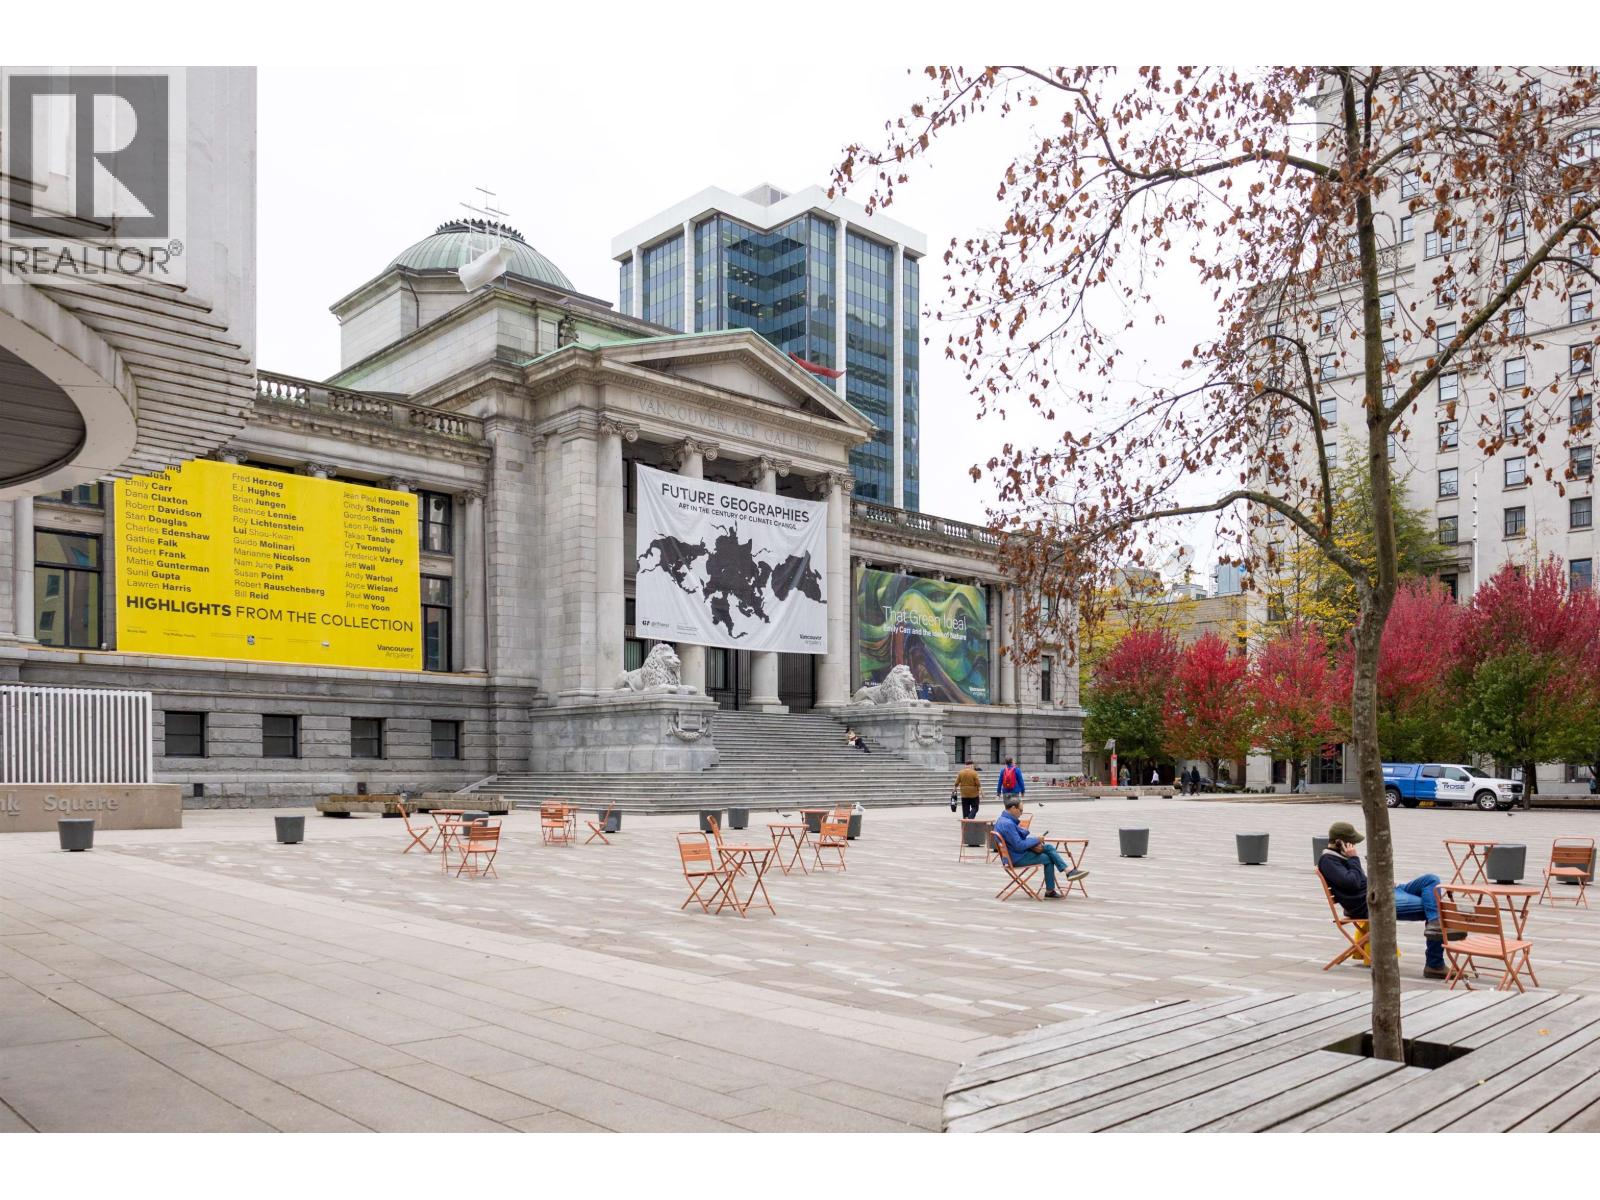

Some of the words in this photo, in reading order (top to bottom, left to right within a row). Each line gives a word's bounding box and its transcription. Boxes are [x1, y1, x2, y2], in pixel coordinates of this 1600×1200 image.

[639, 399, 728, 432] VANCOUVER
[732, 423, 759, 438] ART
[764, 430, 820, 454] GALLERY
[126, 479, 149, 489] Emily
[152, 482, 172, 492] Carr
[232, 473, 250, 482] Fred
[253, 477, 284, 489] Herzog
[126, 489, 148, 499] Dana
[151, 493, 188, 505] Claxton
[248, 487, 280, 498] Hughes
[233, 494, 253, 504] Brian
[256, 498, 286, 509] Jungen
[378, 497, 409, 507] Riopelle
[661, 483, 715, 506] FUTURE
[720, 496, 810, 523] GEOGRAPHIES
[126, 500, 154, 510] Robert
[158, 505, 202, 518] Davidson
[233, 505, 265, 516] Beatrice
[268, 510, 296, 520] Lennie
[344, 502, 364, 511] Cindy
[366, 505, 400, 515] Sherman
[678, 502, 690, 510] ART
[712, 508, 738, 519] CENTURY
[748, 516, 773, 526] CLIMATE
[126, 512, 146, 520] Stan
[149, 515, 188, 526] Douglas
[233, 516, 248, 525] Roy
[250, 518, 304, 531] Lichtenstein
[344, 512, 370, 520] Gordon
[372, 516, 394, 524] Smith
[126, 522, 159, 534] Charles
[162, 528, 210, 540] Edenshaw
[381, 526, 402, 535] Smith
[126, 534, 155, 544] Gathie
[158, 538, 178, 547] Falk
[233, 537, 257, 546] Guido
[260, 540, 295, 551] Molinari
[367, 534, 395, 543] Tanabe
[126, 545, 156, 555] Robert
[159, 550, 186, 559] Frank
[345, 542, 354, 550] Cy
[356, 543, 391, 554] Twombly
[234, 547, 270, 558] Marianne
[273, 553, 310, 563] Nicolson
[380, 556, 404, 565] Varley
[126, 556, 154, 566] Mattie
[157, 560, 209, 572] Gunterman
[275, 563, 294, 571] Paik
[126, 567, 148, 576] Sunil
[152, 570, 180, 580] Gupta
[234, 569, 258, 578] Susan
[261, 572, 283, 580] Point
[345, 572, 363, 581] Andy
[366, 574, 392, 582] Warhol
[127, 580, 159, 589] Lawren
[162, 583, 192, 592] Harris
[234, 579, 261, 589] Robert
[264, 582, 325, 596] Rauschenberg
[367, 584, 398, 592] Wieland
[250, 592, 269, 600] Reid
[363, 594, 385, 602] Wong
[126, 595, 232, 617] HIGHLIGHTS
[236, 605, 283, 622] FROM
[287, 610, 316, 624] THE
[321, 613, 414, 632] COLLECTION
[377, 644, 414, 652] Vancouver
[42, 794, 120, 816] Square
